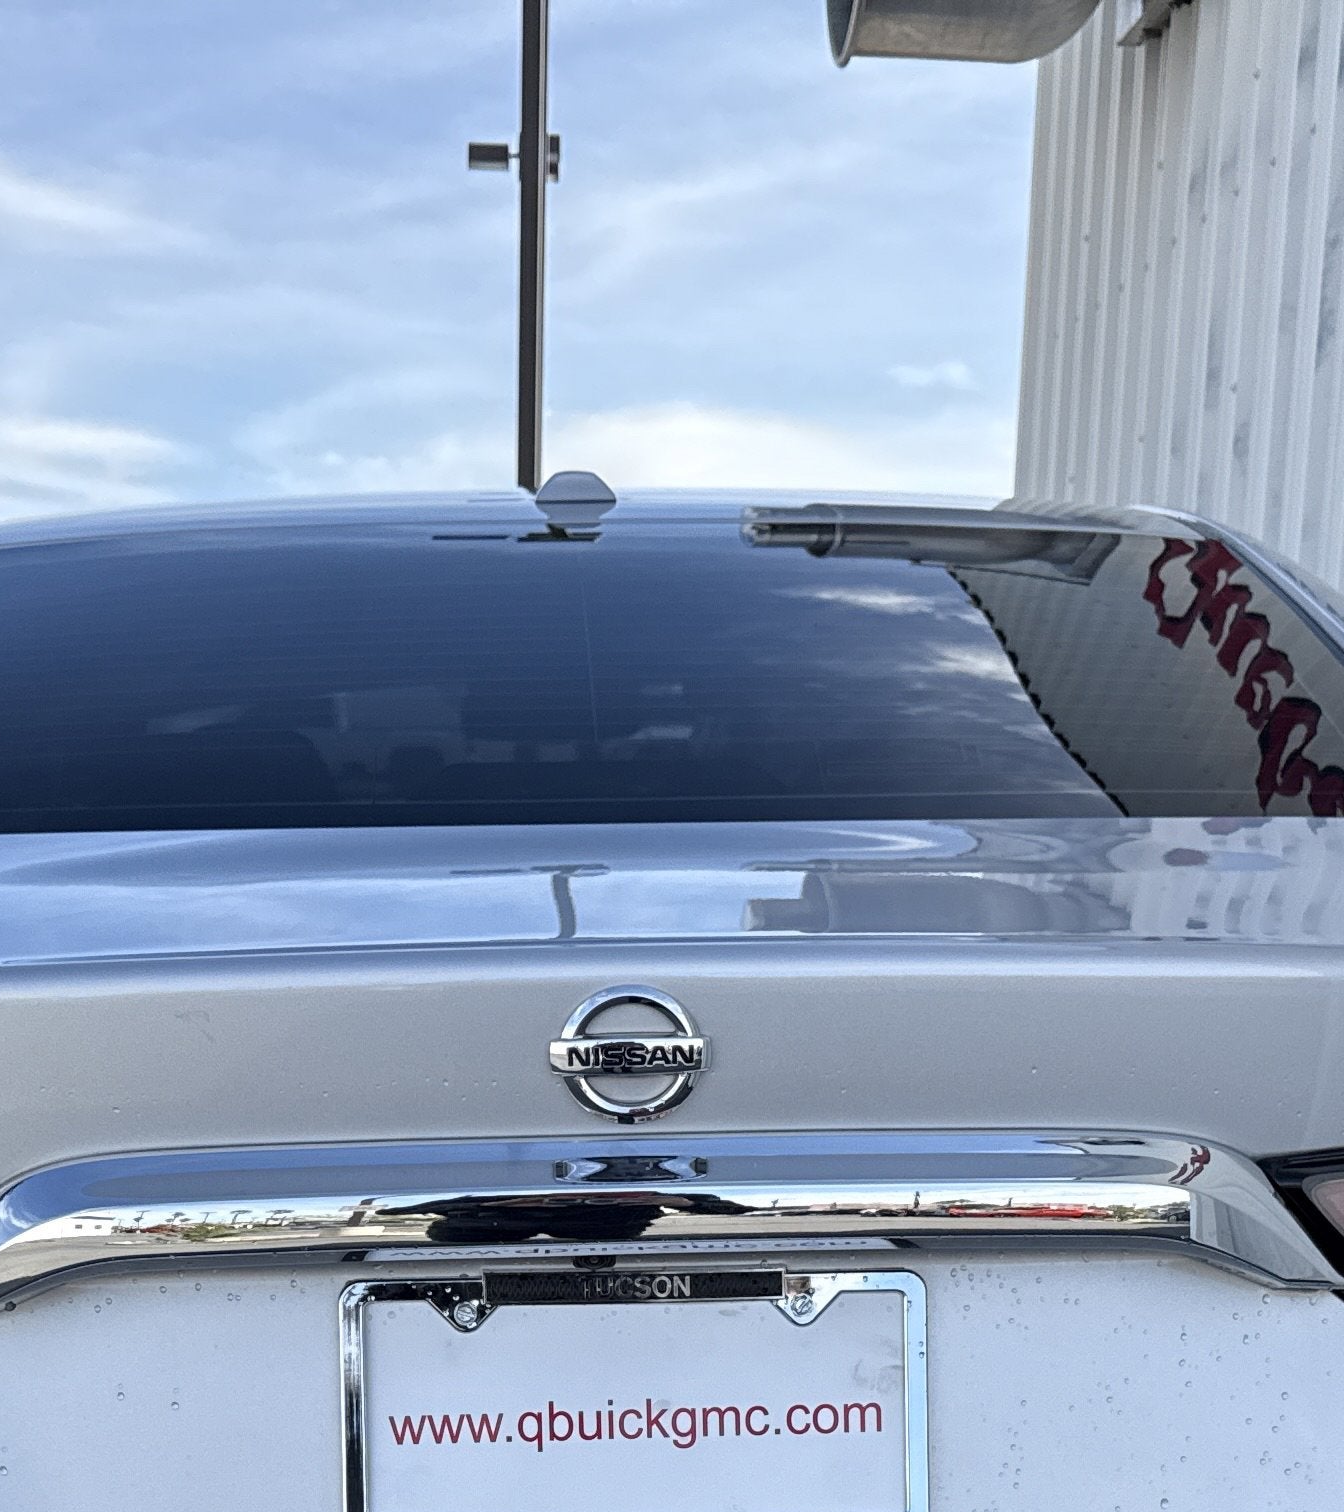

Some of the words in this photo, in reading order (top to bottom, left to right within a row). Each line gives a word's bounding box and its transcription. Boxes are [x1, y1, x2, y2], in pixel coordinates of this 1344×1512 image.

[566, 1044, 696, 1068] NISSAN
[578, 1274, 692, 1299] TUCSON
[388, 1398, 883, 1453] www.qbuickgmc.com
